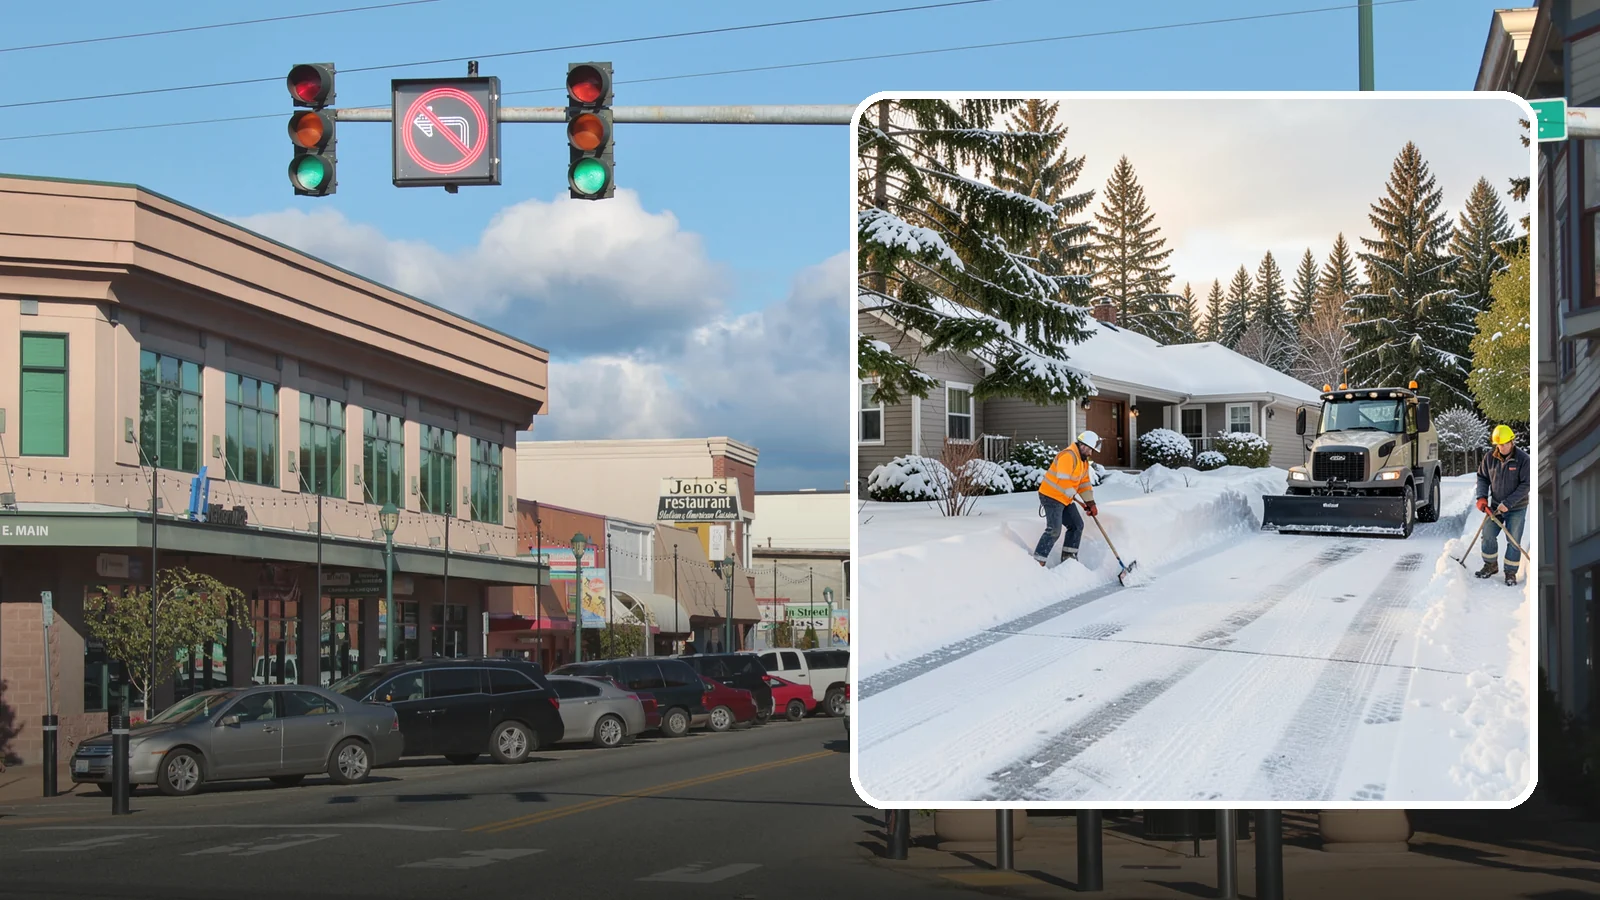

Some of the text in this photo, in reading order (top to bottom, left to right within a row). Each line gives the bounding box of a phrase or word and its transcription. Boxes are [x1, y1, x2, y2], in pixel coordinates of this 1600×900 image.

[670, 480, 727, 494] Jeno's
[665, 497, 730, 508] restaurant
[659, 509, 681, 519] Italian
[685, 509, 714, 519] American
[715, 509, 737, 519] Cuisine
[2, 525, 48, 536] E. MAIN
[786, 607, 794, 616] in
[798, 607, 828, 616] Street
